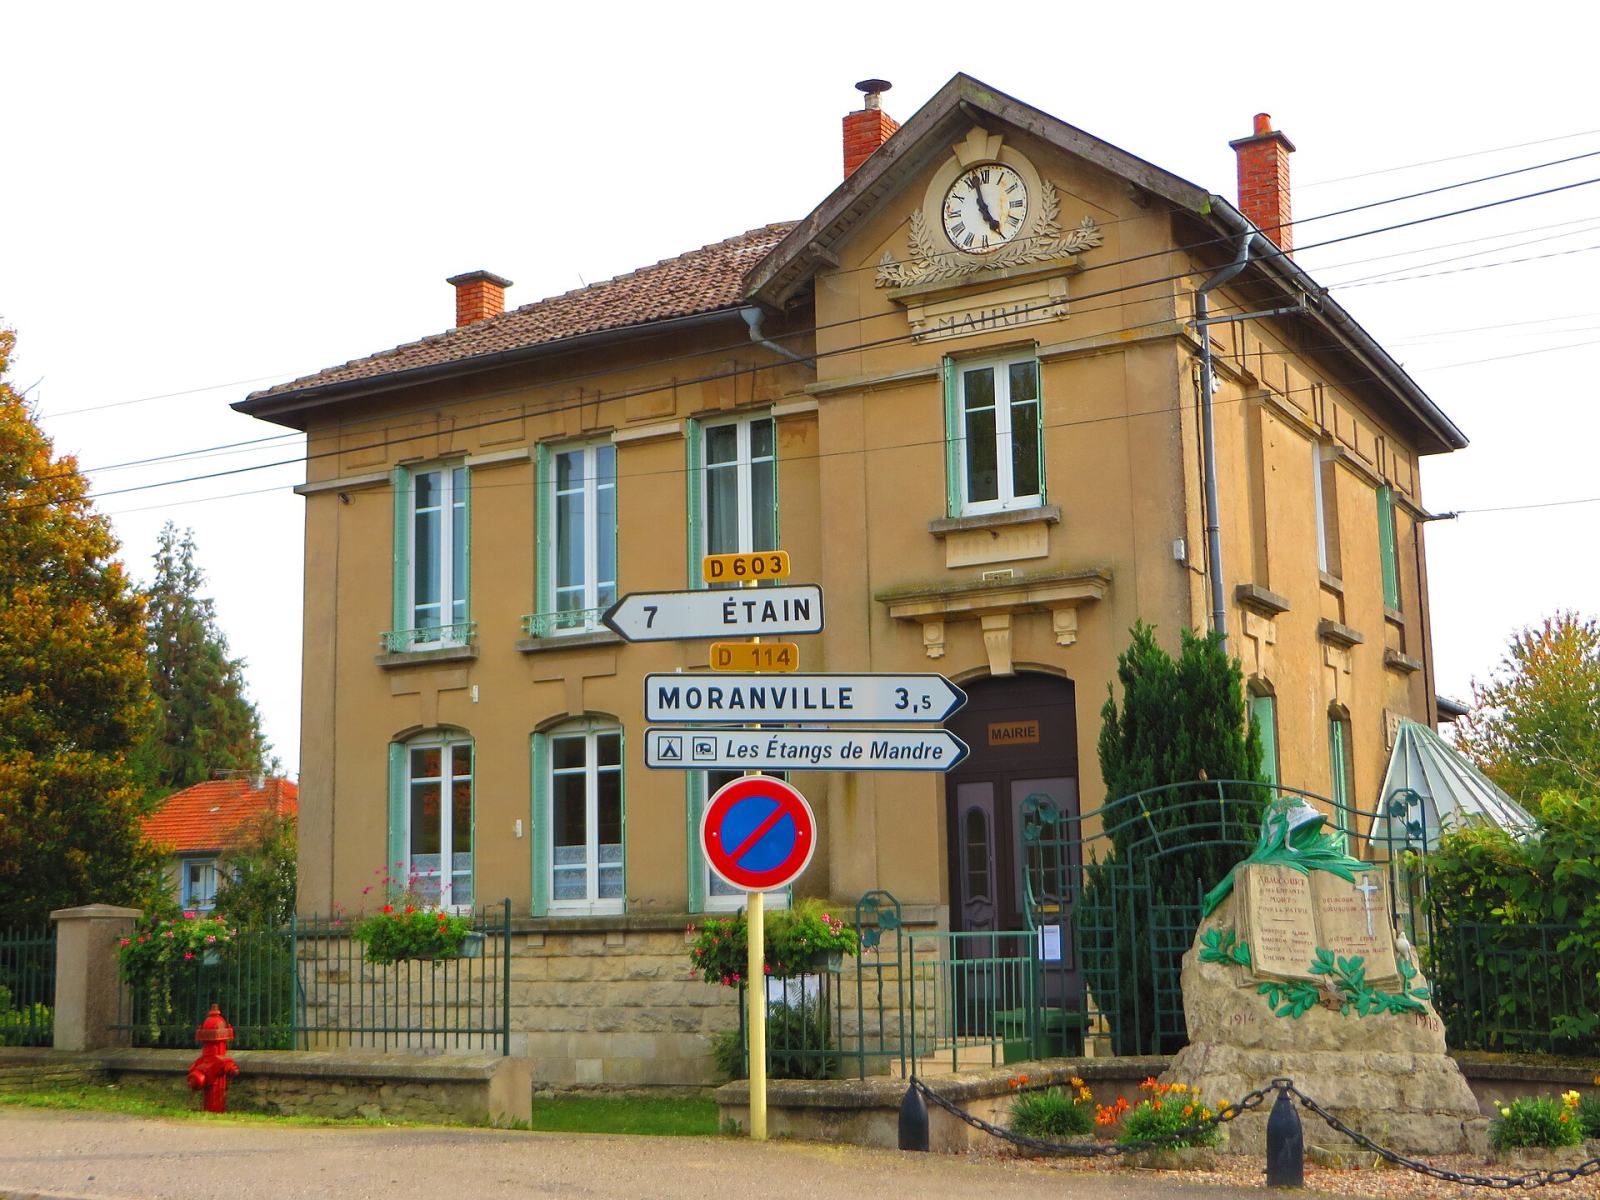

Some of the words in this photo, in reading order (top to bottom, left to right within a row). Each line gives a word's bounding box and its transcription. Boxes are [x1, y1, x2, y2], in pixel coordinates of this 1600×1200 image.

[710, 559, 724, 578] D
[733, 555, 782, 576] 603
[643, 605, 658, 629] 7
[722, 596, 810, 624] ÉTAIN
[718, 647, 732, 666] D
[751, 647, 791, 666] 114
[658, 686, 853, 710] MORANVILLE
[894, 687, 932, 714] 3,5
[991, 726, 1036, 740] MAIRIE
[726, 739, 759, 759] Les
[766, 734, 832, 764] Étangs
[840, 741, 863, 760] de
[869, 741, 943, 760] Mandre
